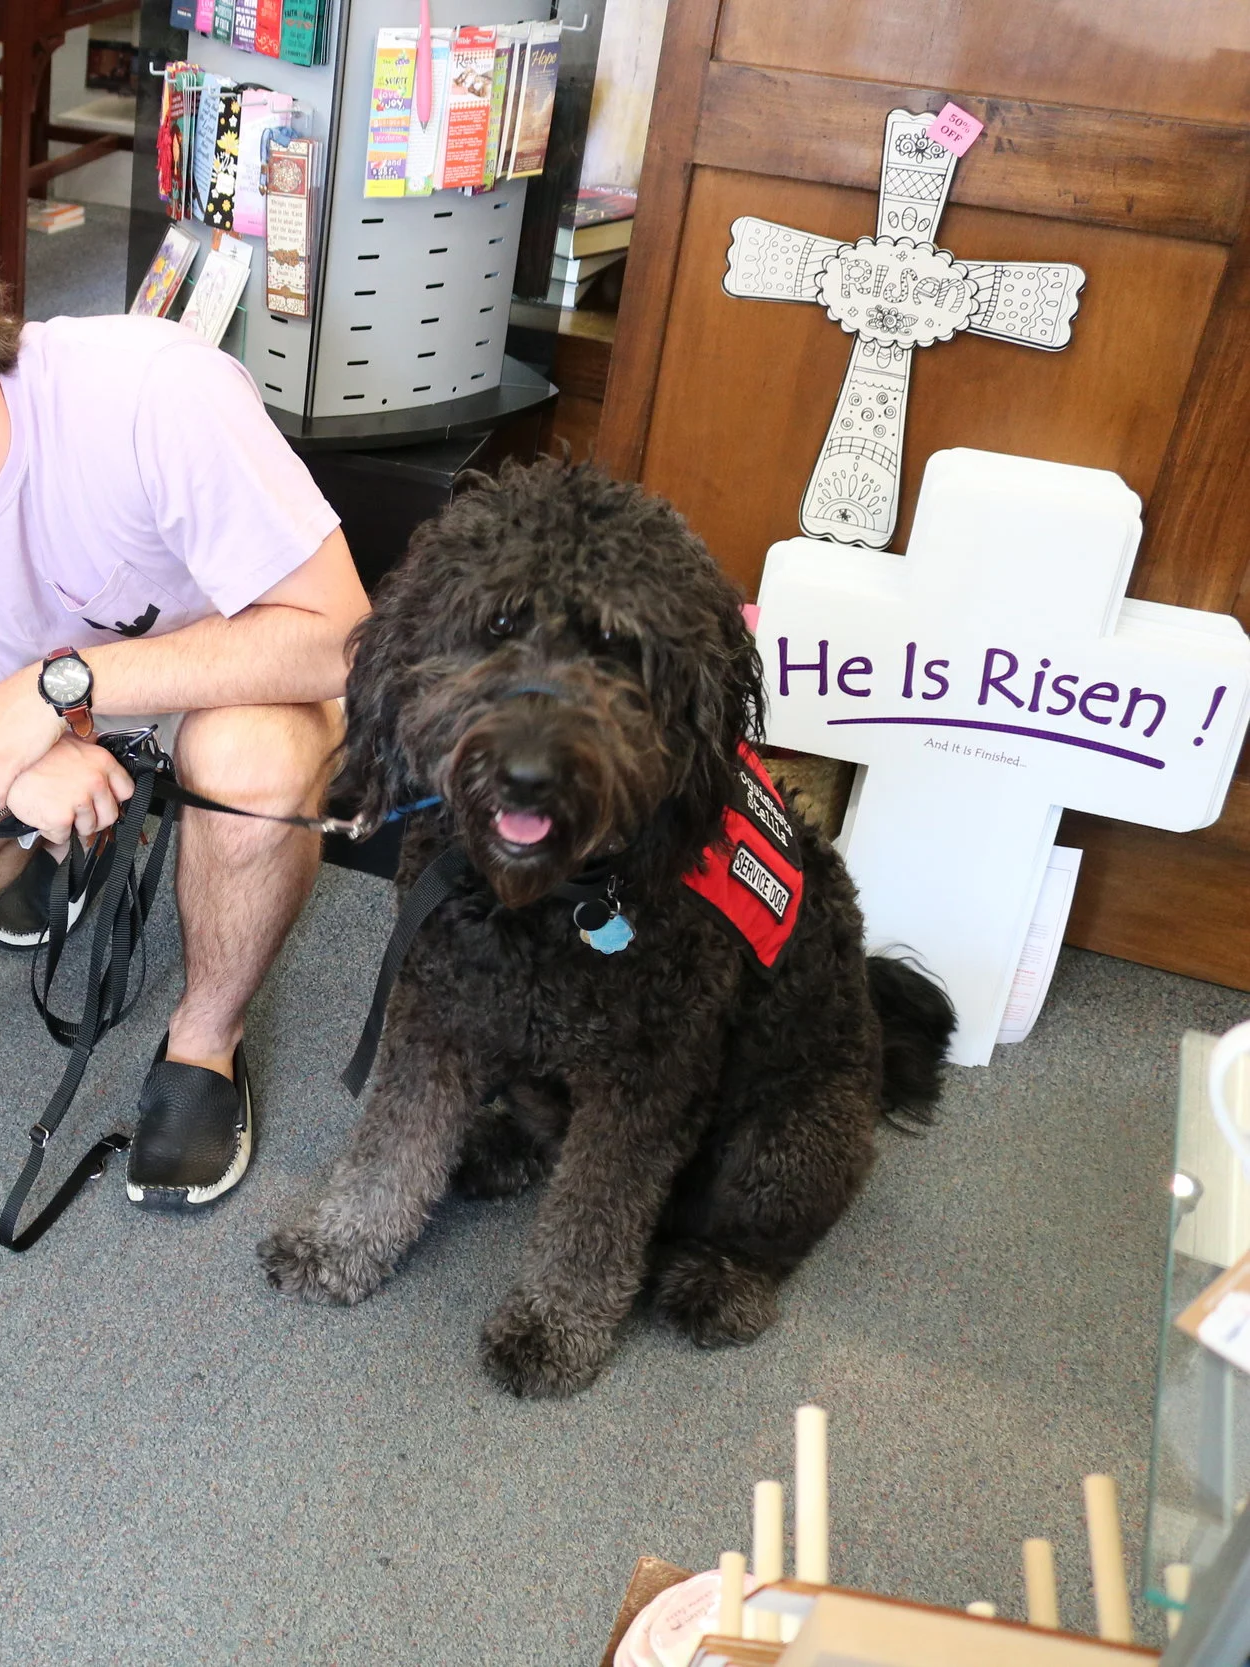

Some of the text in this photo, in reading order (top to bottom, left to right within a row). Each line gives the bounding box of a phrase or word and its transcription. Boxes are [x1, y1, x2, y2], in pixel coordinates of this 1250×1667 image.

[235, 14, 257, 29] PATH
[454, 53, 478, 69] Rest
[532, 49, 558, 73] Hope
[948, 113, 970, 134] 50%
[940, 125, 963, 142] OFF
[777, 636, 1228, 747] He Is Risen !
[923, 738, 949, 752] And
[951, 743, 961, 754] It
[963, 745, 972, 756] Is
[734, 851, 787, 913] SERVICE DOG
